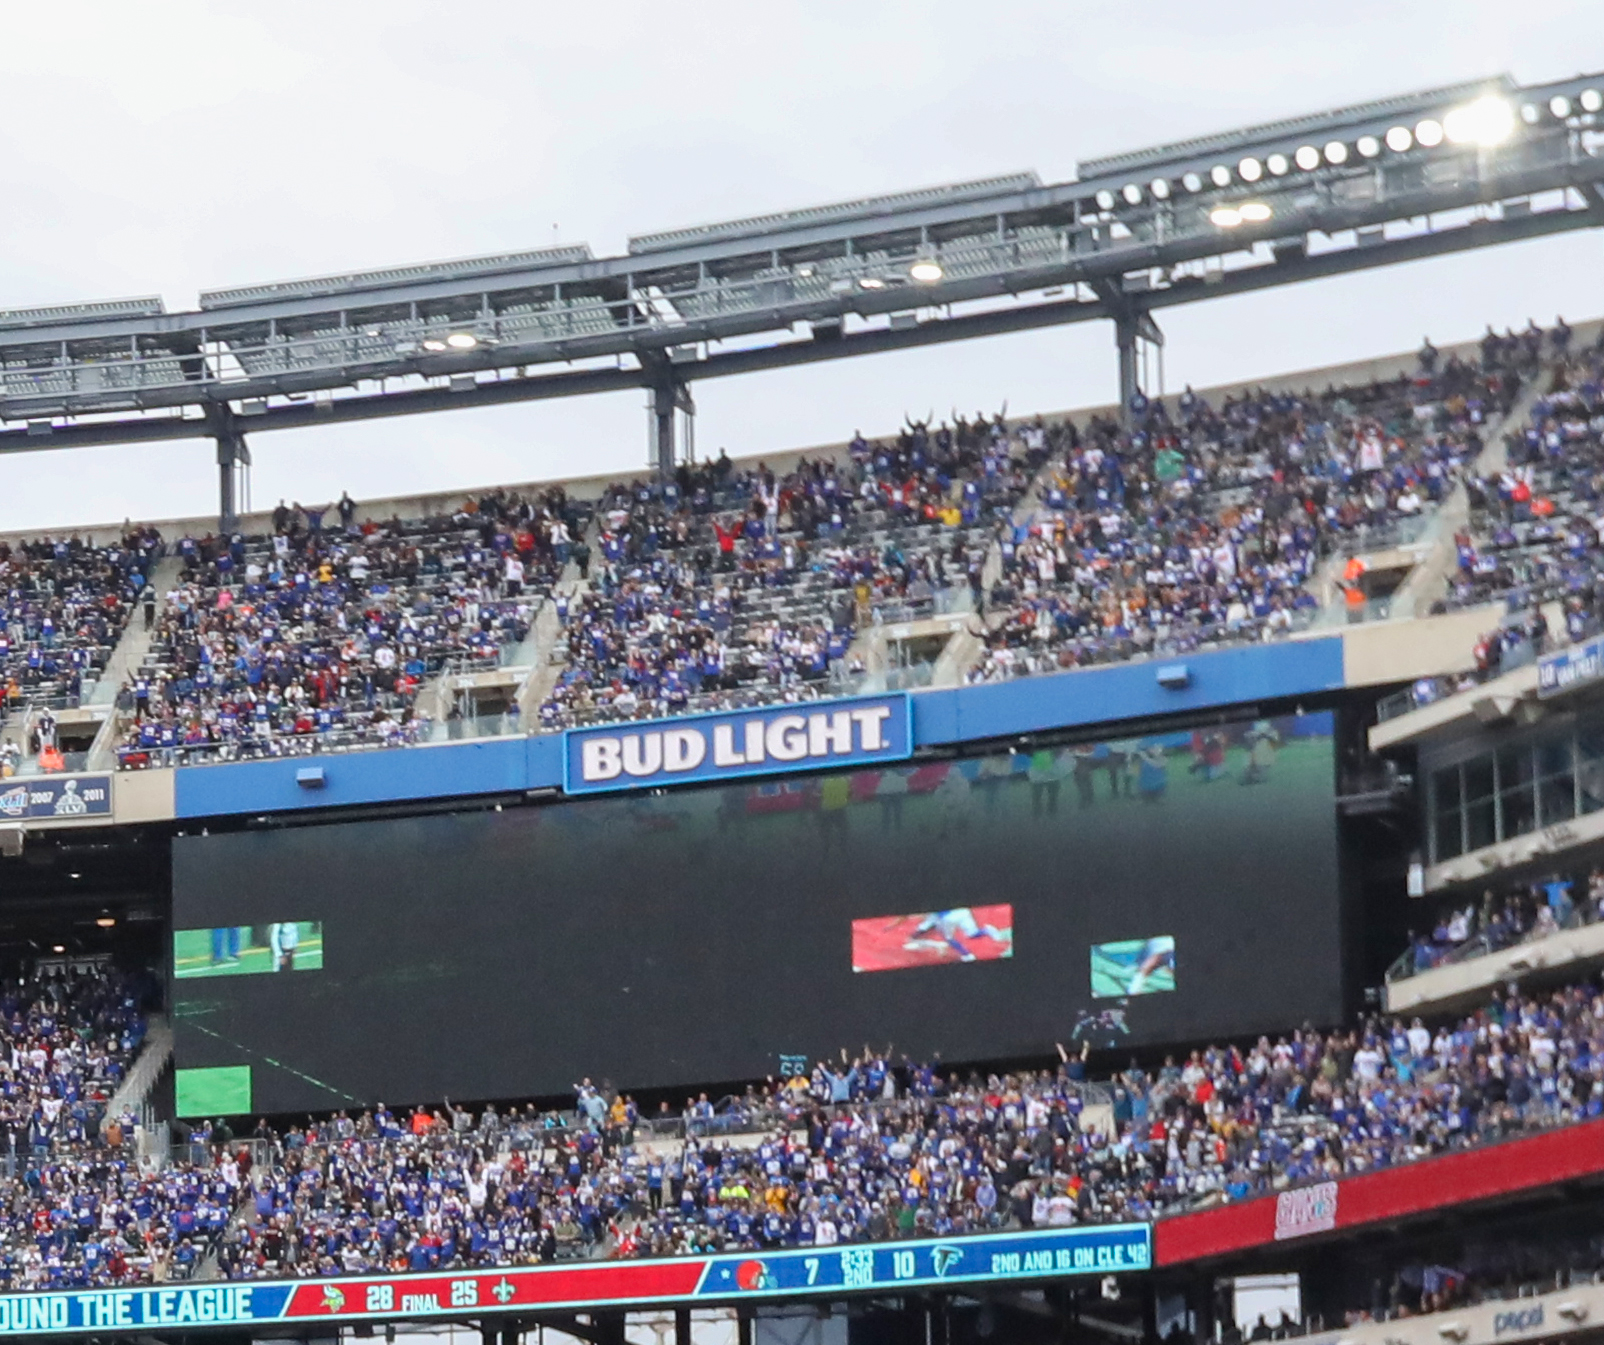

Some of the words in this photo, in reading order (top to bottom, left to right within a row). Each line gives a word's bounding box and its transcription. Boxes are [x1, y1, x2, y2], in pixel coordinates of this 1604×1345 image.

[583, 729, 706, 780] BUD
[31, 792, 53, 804] 2007
[83, 789, 104, 801] 2011
[805, 1259, 819, 1286] 7
[842, 1249, 873, 1268] 2:33
[894, 1251, 915, 1279] 10
[992, 1254, 1021, 1275] 2ND
[1024, 1252, 1053, 1273] AND
[1074, 1248, 1096, 1269] ON
[1100, 1246, 1124, 1268] CLE
[1126, 1243, 1146, 1266] 42
[844, 1268, 872, 1286] 2ND
[76, 1292, 132, 1326] THE
[141, 1287, 253, 1322] LEAGUE
[367, 1285, 392, 1311] 28
[401, 1292, 442, 1313] FINAL
[451, 1281, 476, 1306] 25
